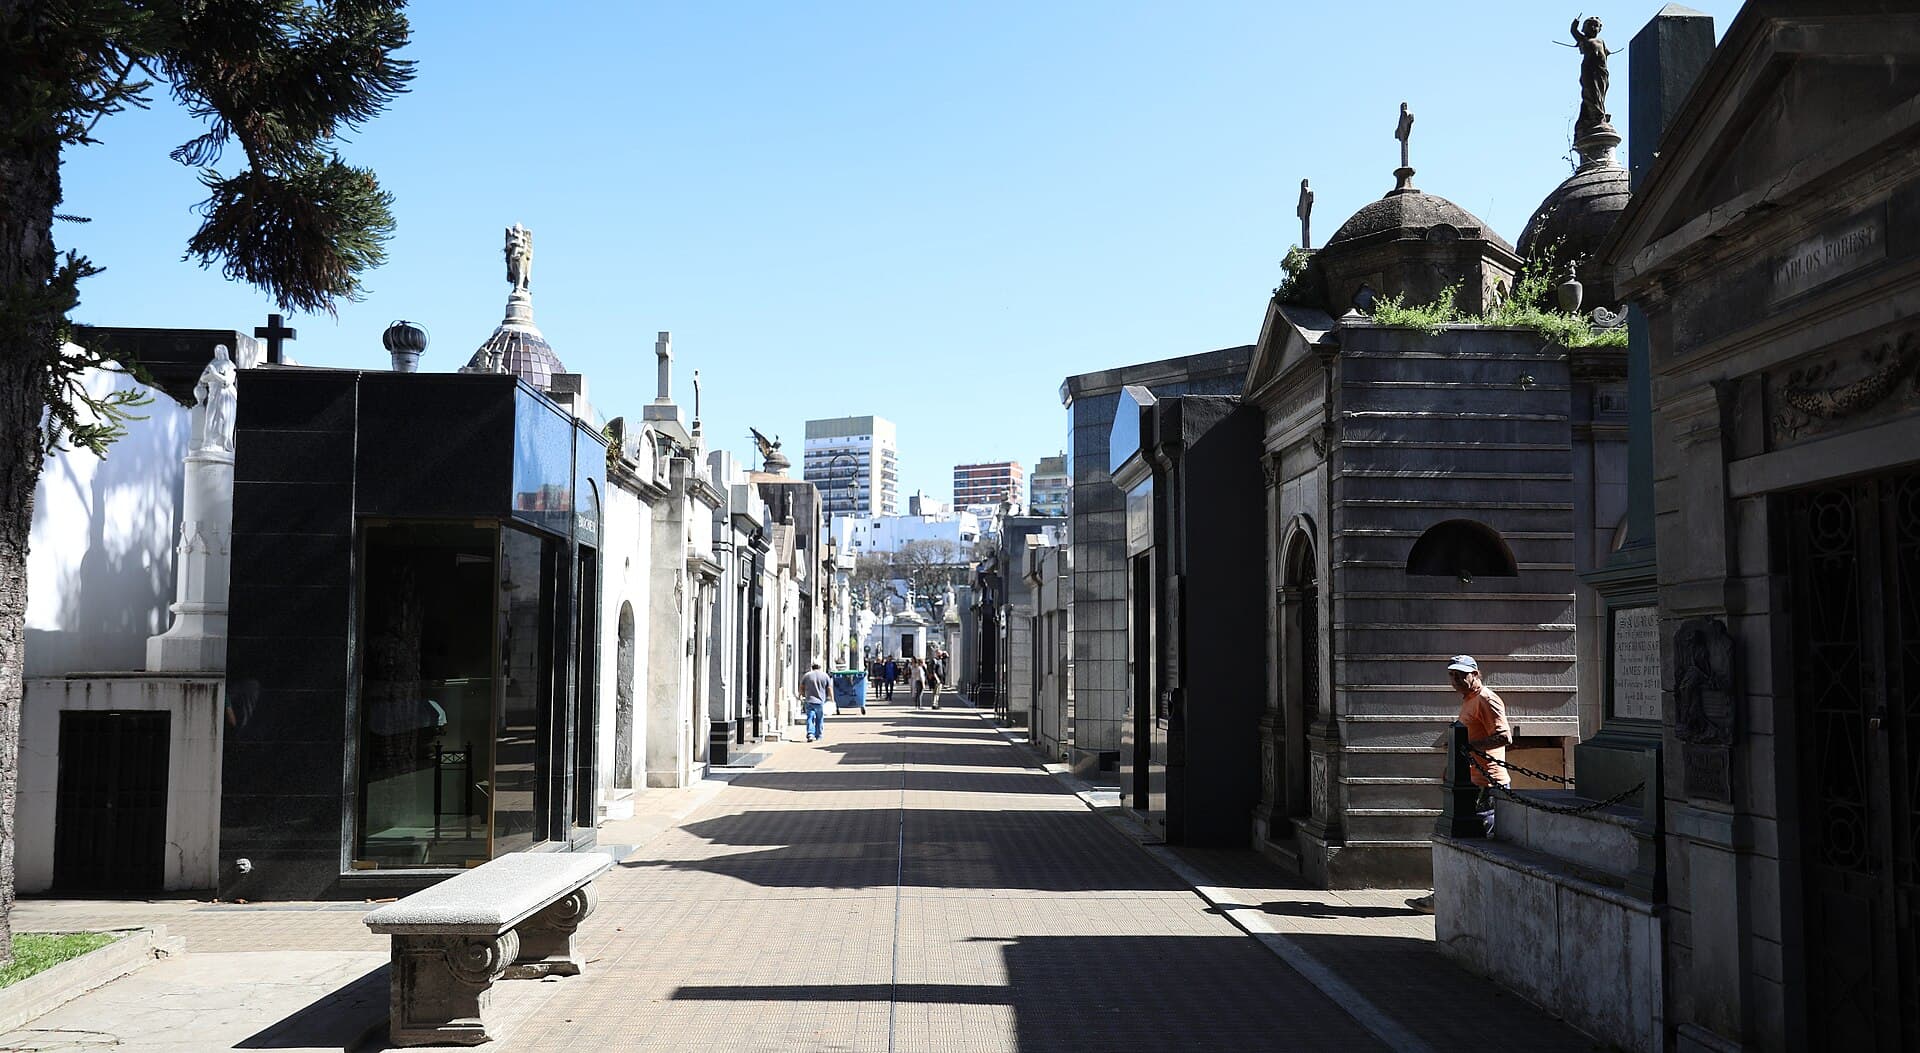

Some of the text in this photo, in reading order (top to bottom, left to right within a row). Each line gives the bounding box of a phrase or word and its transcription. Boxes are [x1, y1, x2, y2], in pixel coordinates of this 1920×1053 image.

[1776, 226, 1873, 284] CARLOS FOREST
[1623, 665, 1641, 676] JAMES
